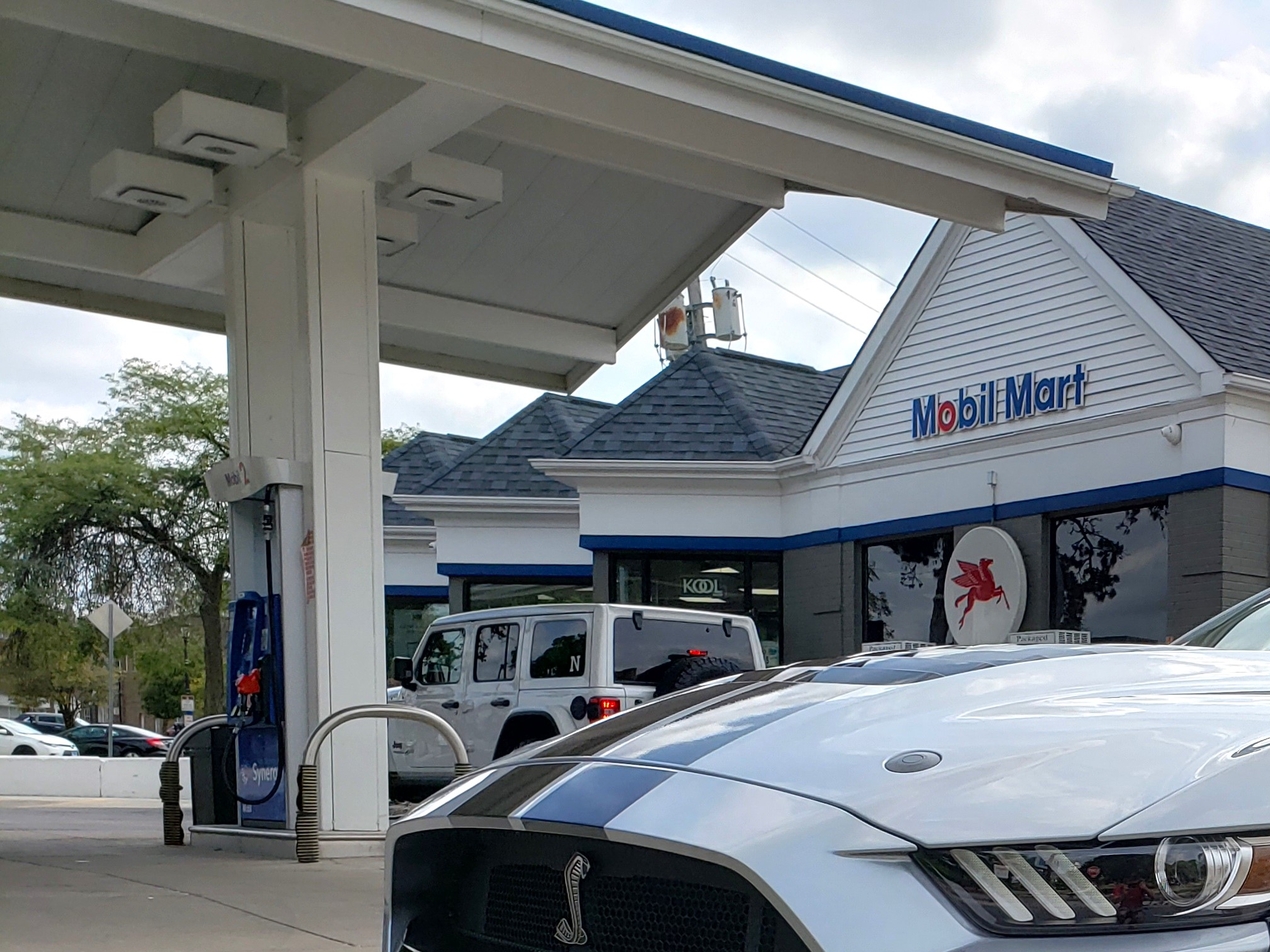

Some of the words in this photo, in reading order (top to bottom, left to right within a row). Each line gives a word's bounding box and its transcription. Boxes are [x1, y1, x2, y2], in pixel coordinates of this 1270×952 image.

[911, 380, 997, 440] Mobil
[1005, 363, 1087, 421] Mart
[683, 578, 723, 596] KOOL
[569, 654, 581, 673] N
